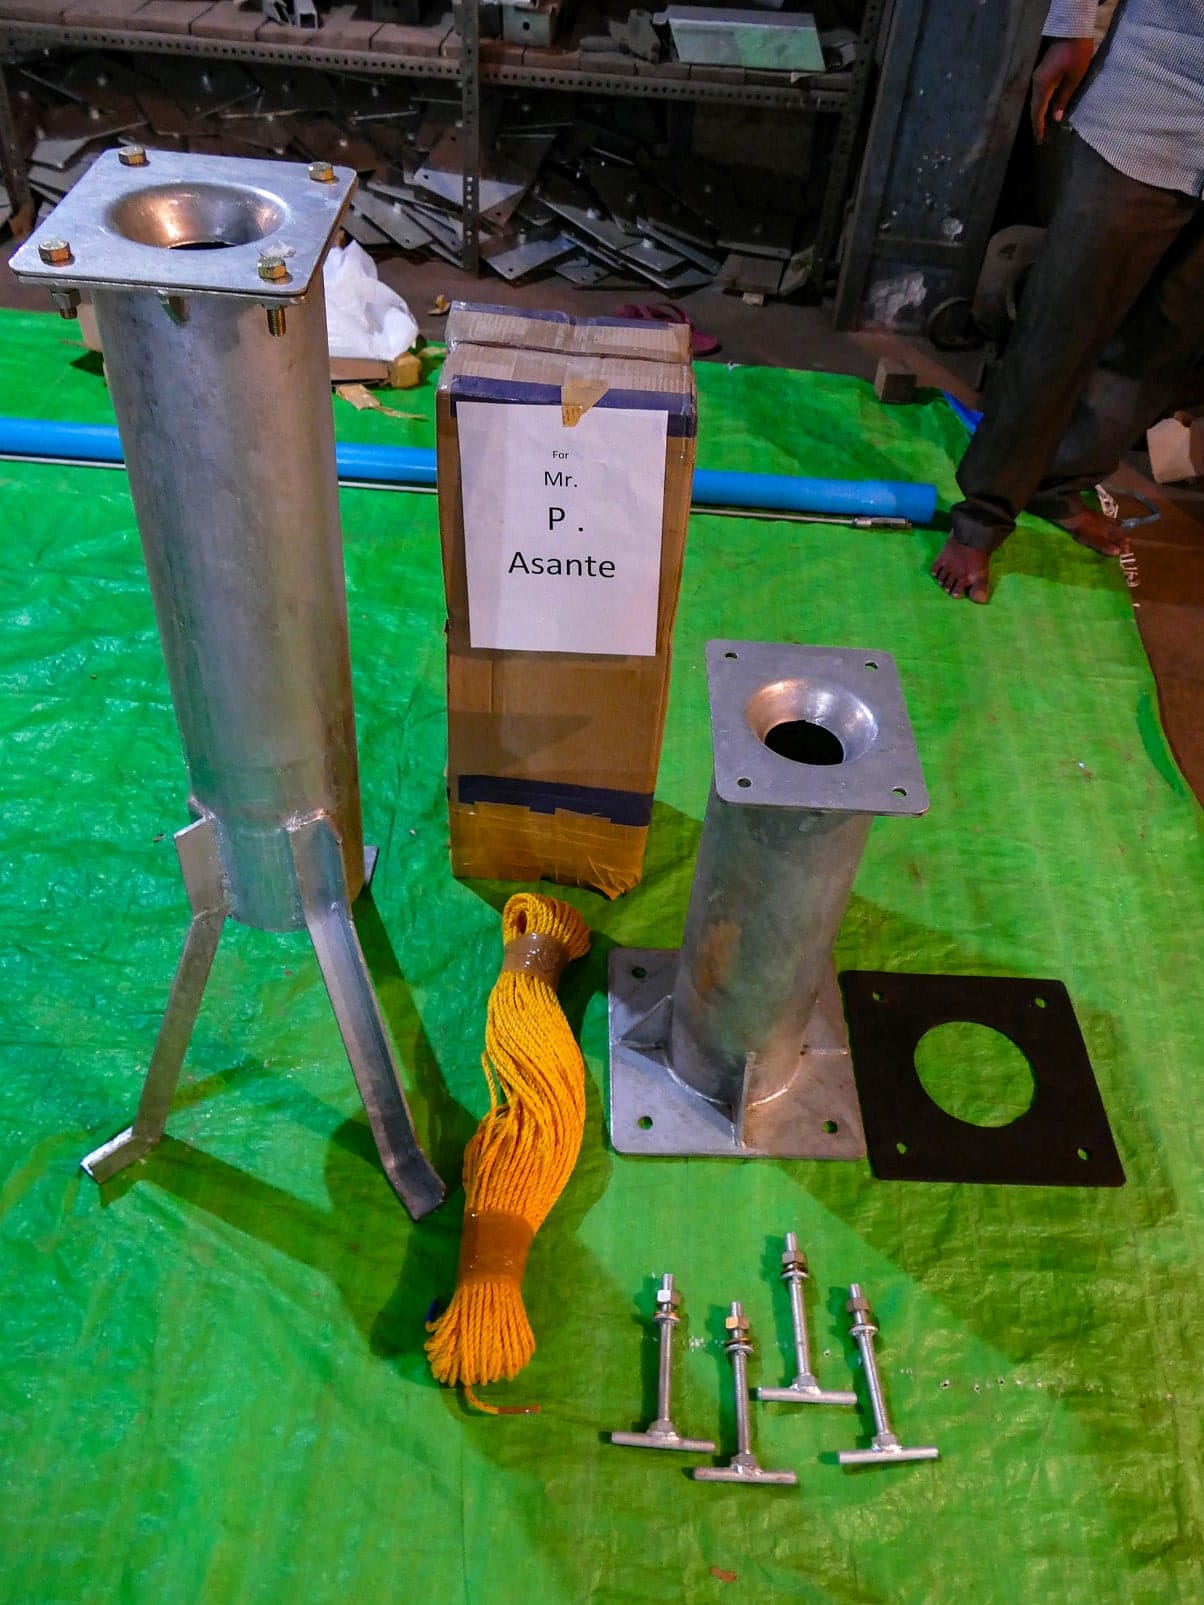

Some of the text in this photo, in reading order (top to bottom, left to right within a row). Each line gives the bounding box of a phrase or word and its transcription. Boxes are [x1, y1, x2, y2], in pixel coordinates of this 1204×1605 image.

[552, 450, 569, 459] For
[544, 471, 578, 488] Mr.
[508, 551, 616, 578] Asante
